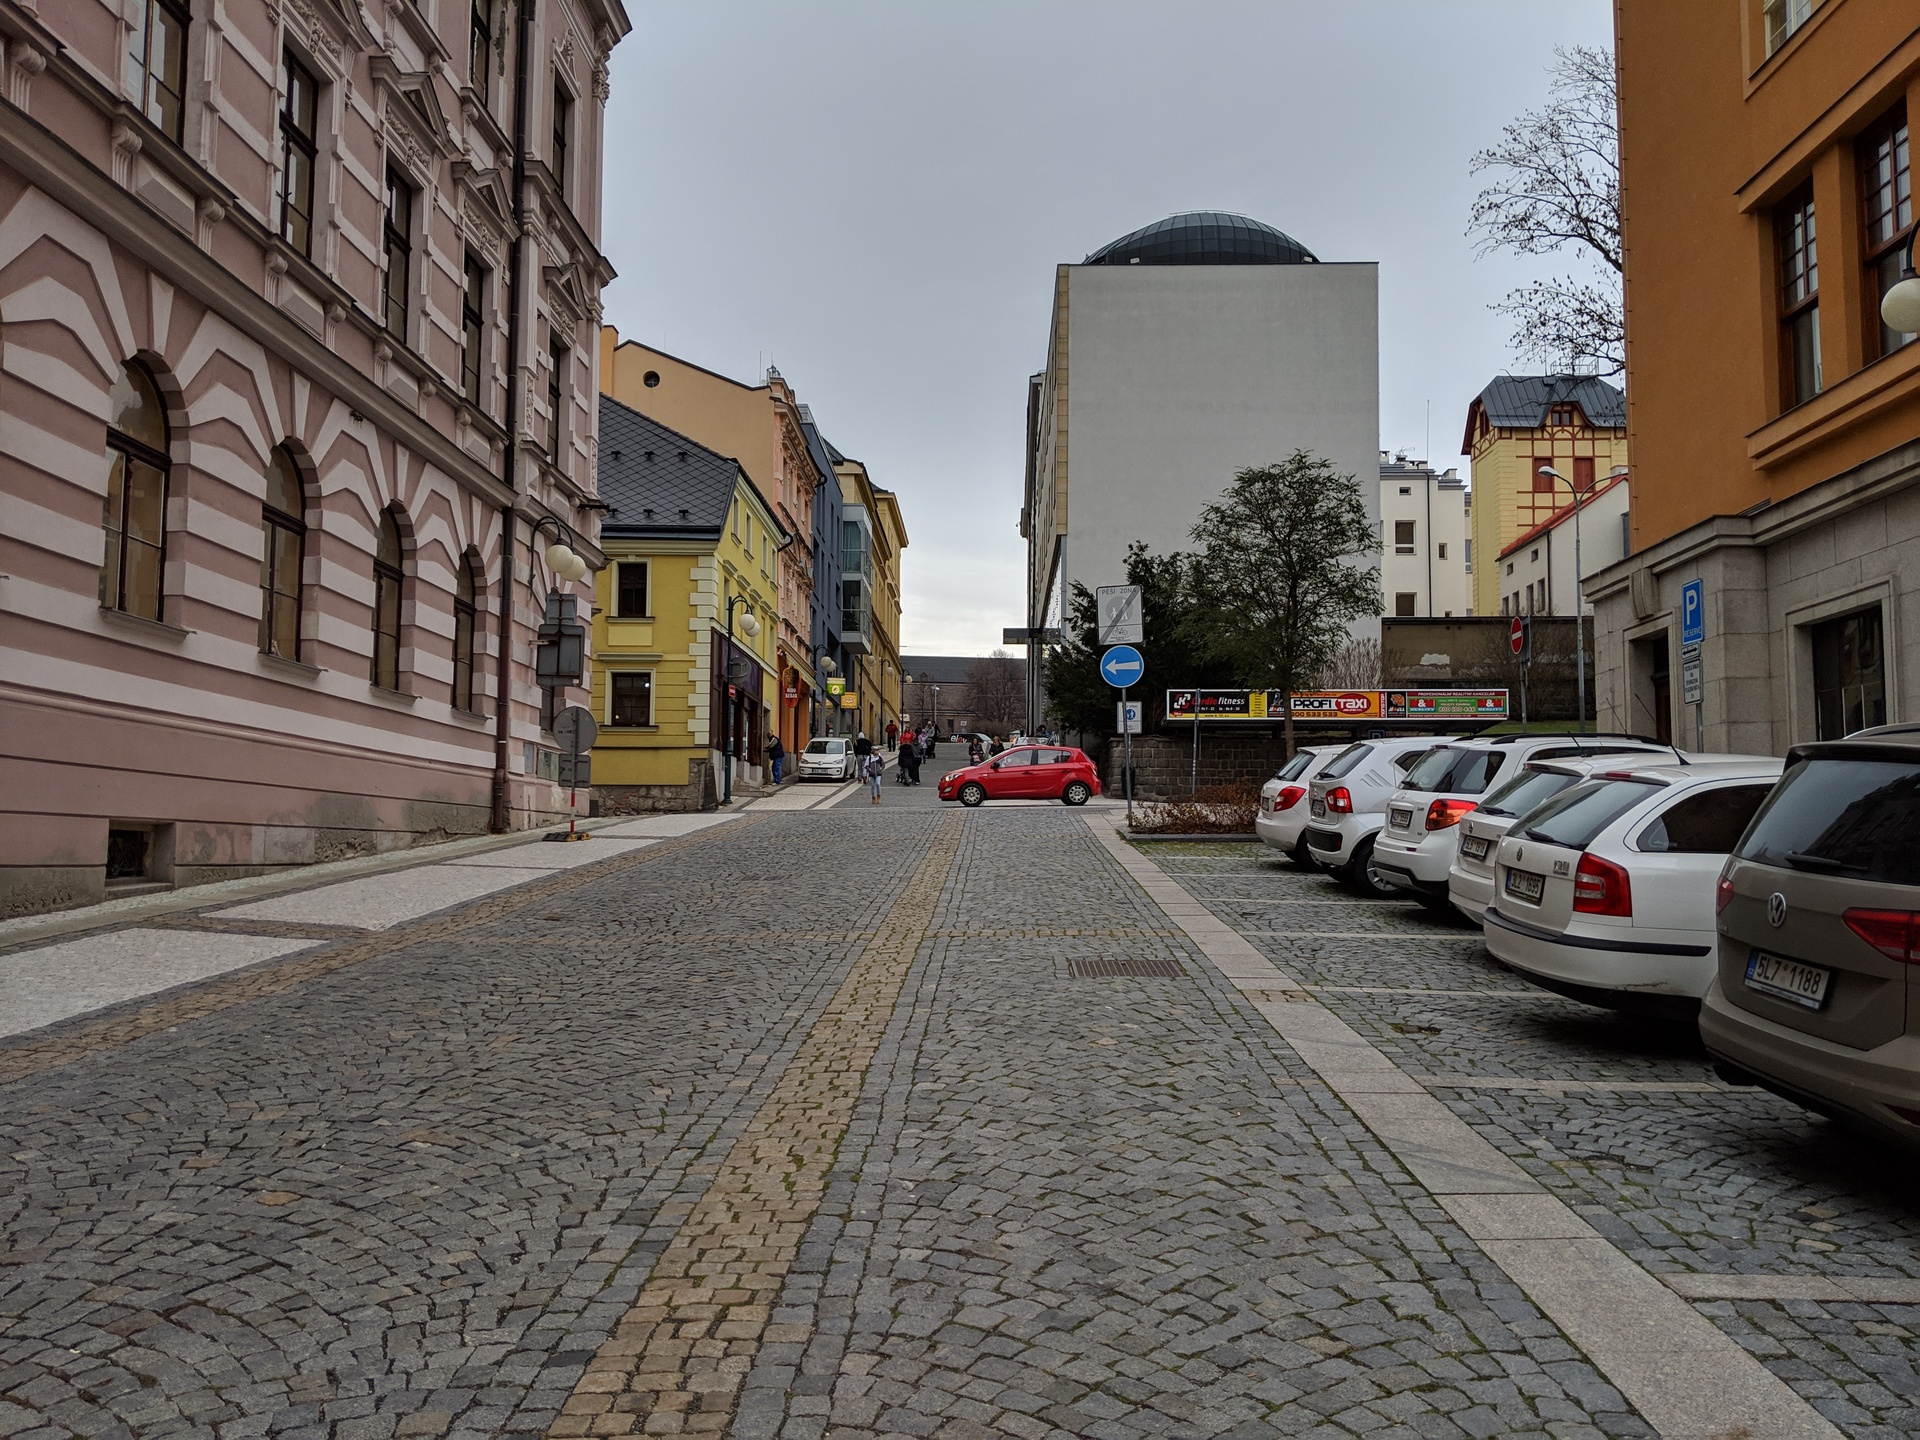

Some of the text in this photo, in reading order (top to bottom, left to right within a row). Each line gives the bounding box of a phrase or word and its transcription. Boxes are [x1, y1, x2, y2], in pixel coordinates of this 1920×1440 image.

[1685, 589, 1698, 626] P
[1293, 700, 1331, 709] PROFI
[1756, 955, 1783, 982] 5L7
[1789, 965, 1822, 995] 1188
